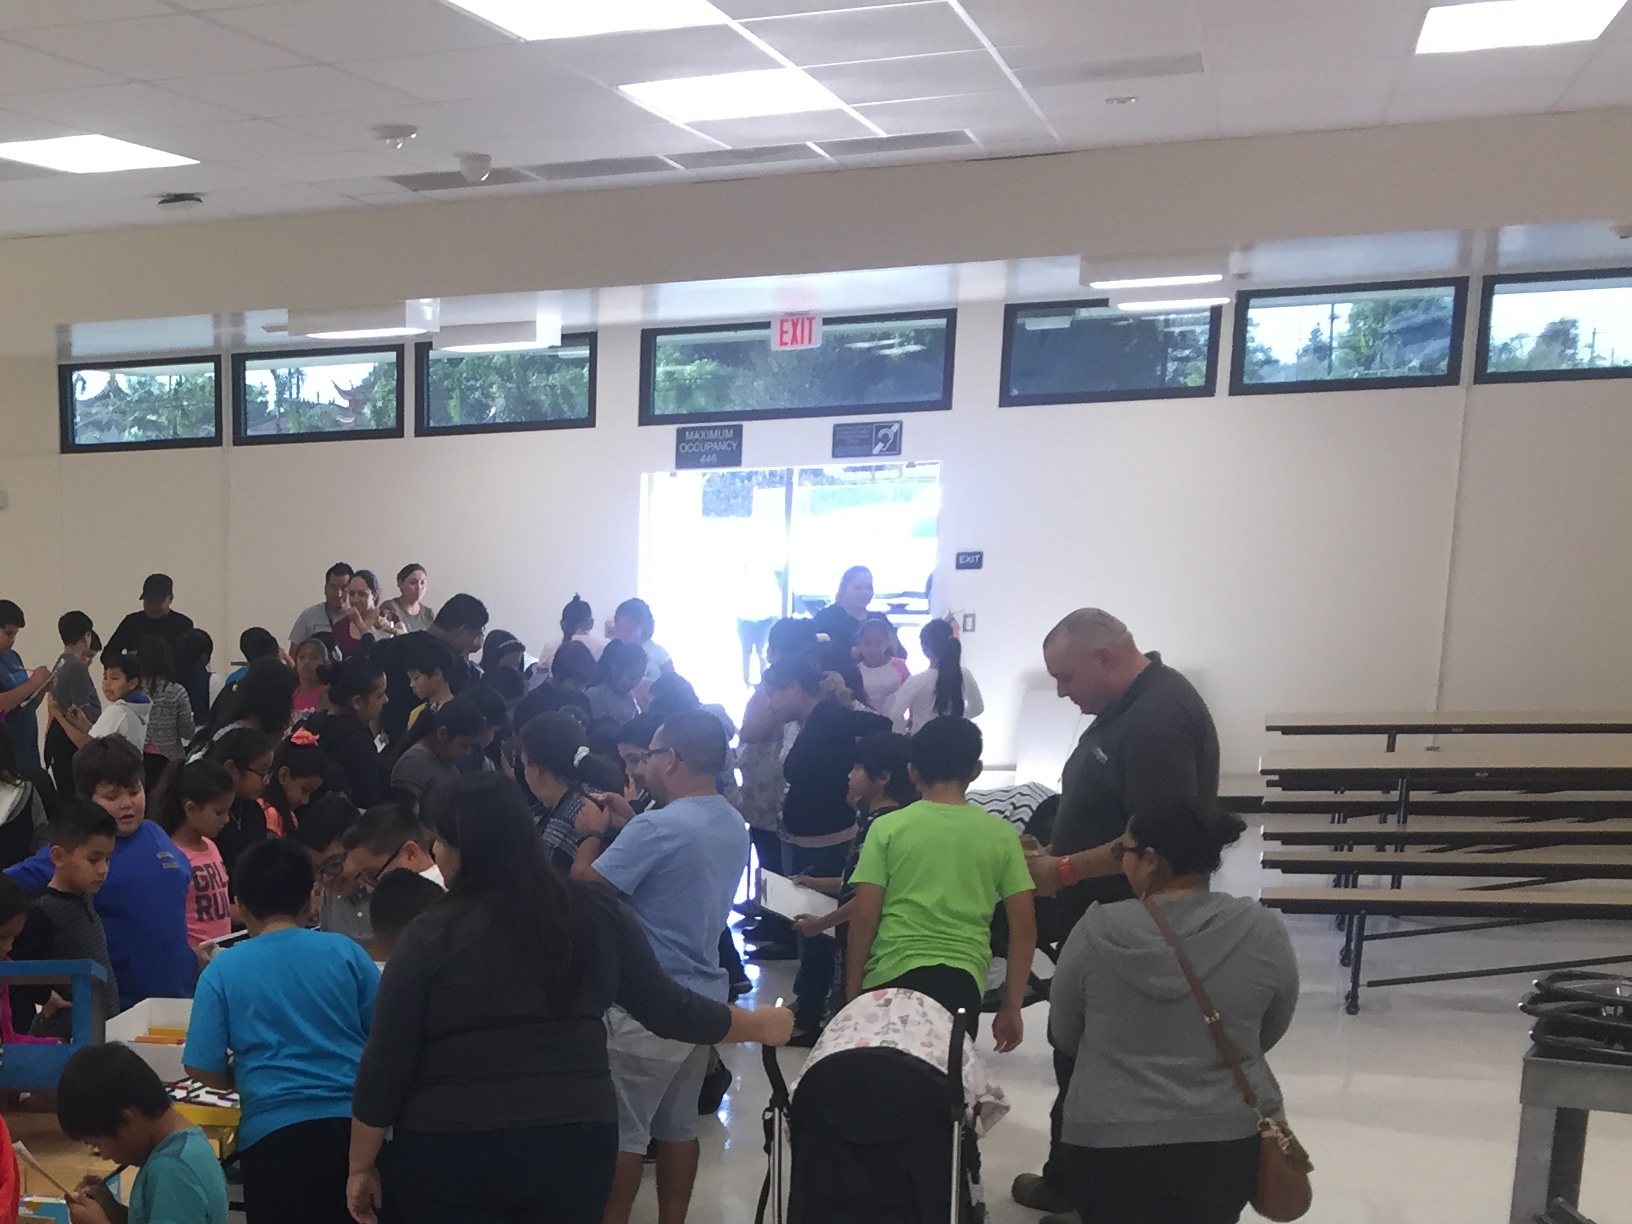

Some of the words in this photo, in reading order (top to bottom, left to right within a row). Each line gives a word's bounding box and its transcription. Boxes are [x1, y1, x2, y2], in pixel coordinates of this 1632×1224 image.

[779, 316, 815, 346] EXIT
[685, 429, 734, 441] MAXIMUM
[679, 440, 738, 453] OCCUPANCY
[959, 554, 980, 564] EXIT
[191, 861, 228, 893] GRL
